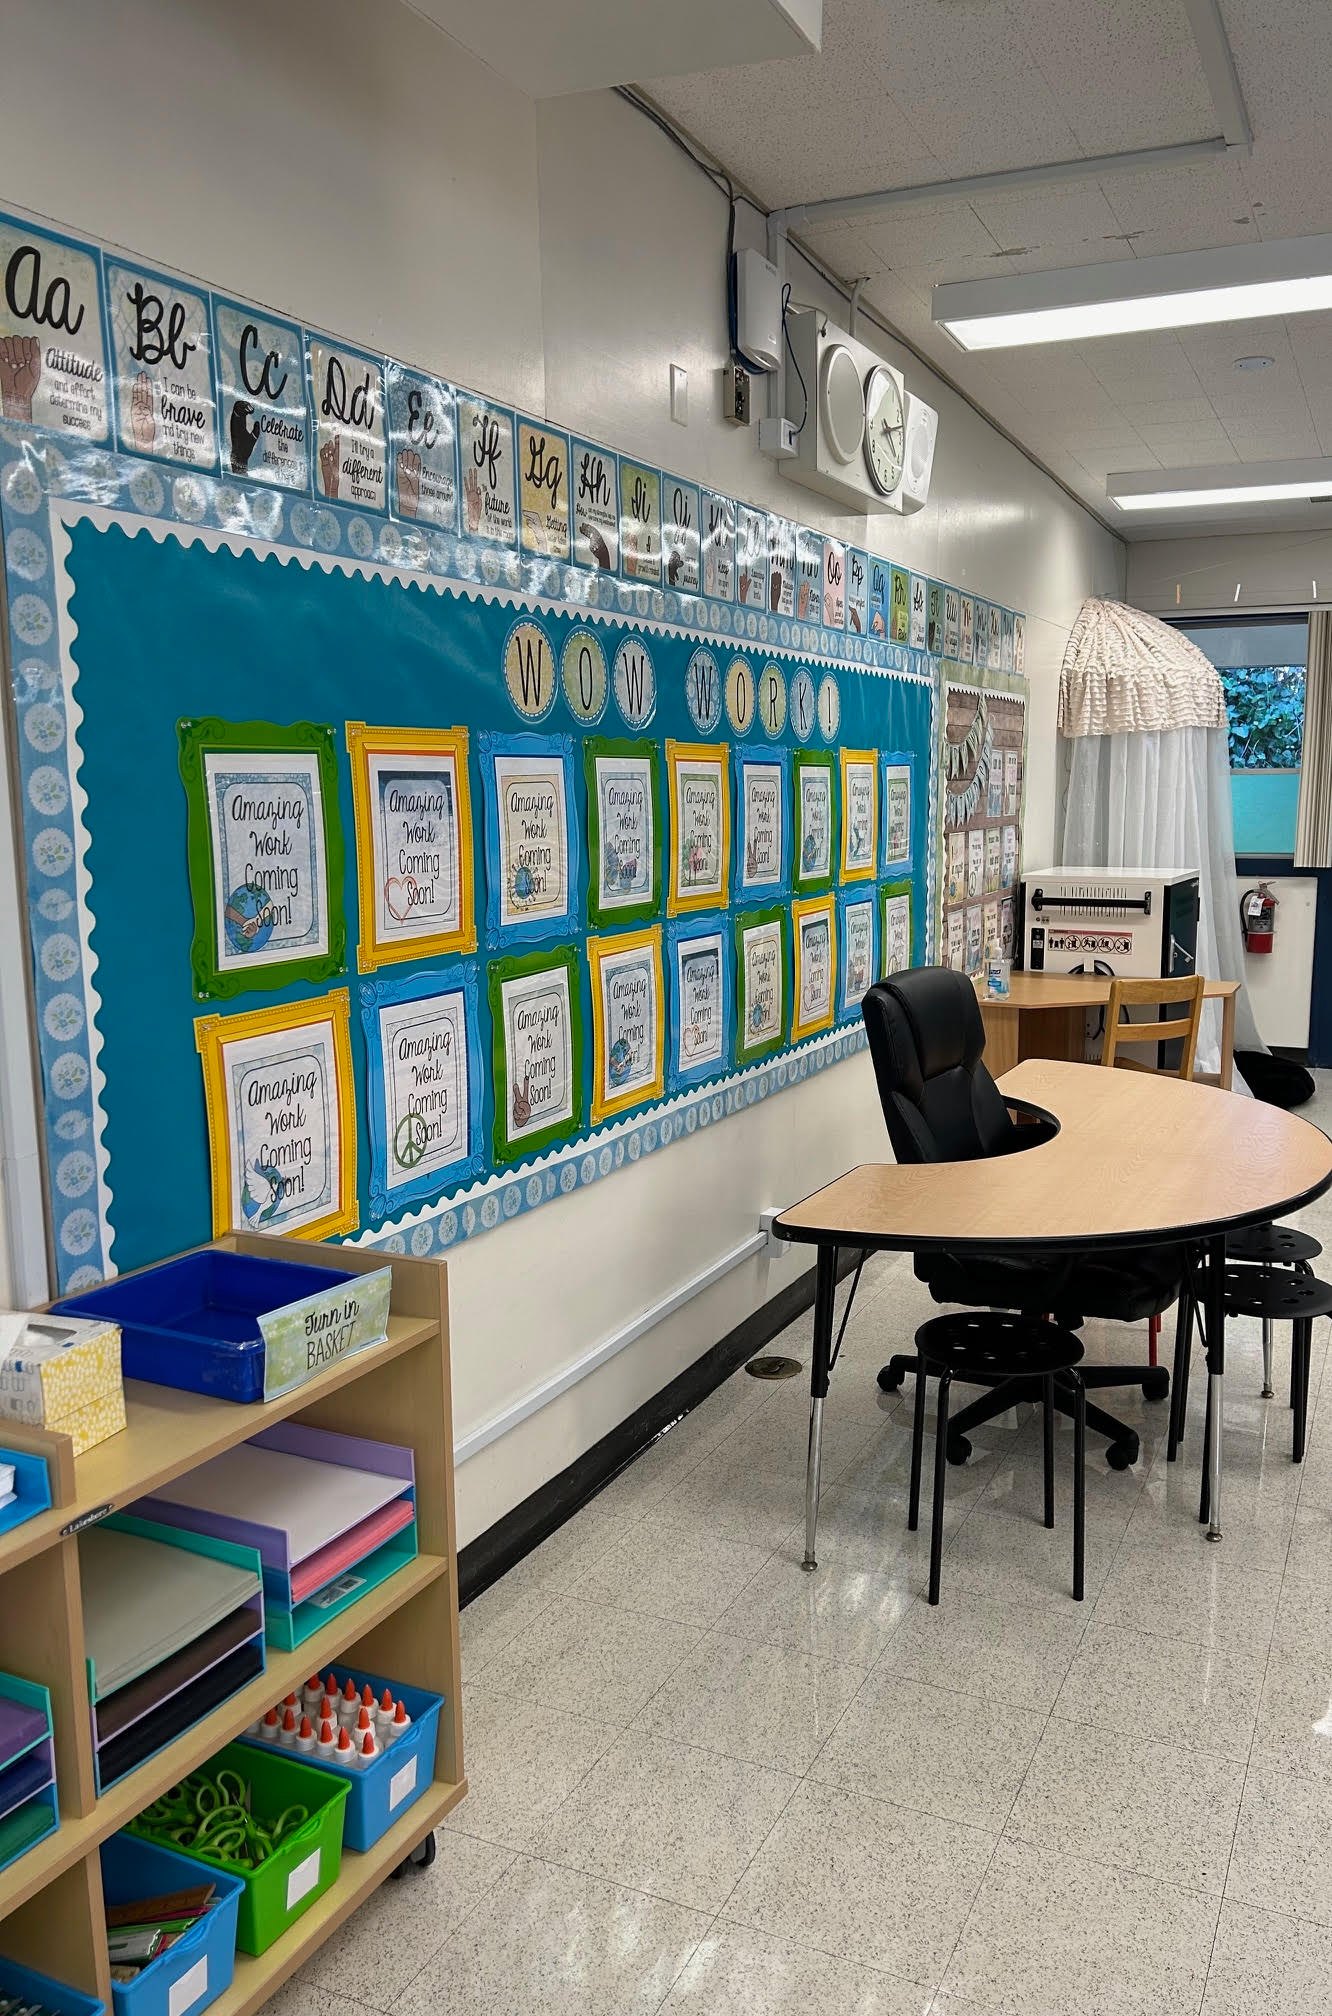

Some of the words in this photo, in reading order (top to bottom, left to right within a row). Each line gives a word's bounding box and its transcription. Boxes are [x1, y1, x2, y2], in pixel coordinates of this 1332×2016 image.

[5, 245, 85, 335] Aa
[126, 282, 196, 370] Bb
[239, 324, 288, 400] Cc
[163, 377, 168, 392] I
[171, 384, 185, 397] can
[187, 384, 196, 400] be
[322, 357, 375, 430] Dd
[161, 395, 205, 429] brave
[176, 427, 189, 445] try
[261, 415, 304, 442] Celebrate
[173, 442, 195, 462] things
[342, 457, 383, 484] different
[485, 491, 511, 515] future
[515, 636, 645, 715] WOW
[694, 662, 833, 732] WORK!
[390, 789, 444, 819] Amazing
[511, 792, 554, 818] Amazing
[609, 787, 643, 811] Amazing
[686, 787, 715, 810] Amazing
[752, 787, 775, 808] Amazing
[232, 794, 304, 830] Amazing
[617, 812, 638, 831] Work
[693, 810, 710, 827] Work
[402, 820, 436, 844] Work
[522, 818, 548, 840] Work
[690, 829, 712, 853] Coming
[753, 826, 772, 847] Coming
[250, 831, 292, 856] Work
[615, 834, 640, 859] Coming
[399, 849, 440, 880] Coming
[519, 845, 551, 871] Coming
[244, 863, 298, 897] Coming
[406, 881, 434, 906] Soon!
[256, 897, 292, 927] Soon!
[686, 961, 716, 983] Amazing
[613, 978, 647, 1001] Amazing
[517, 1004, 560, 1031] Amazing
[621, 1001, 641, 1020] Work
[690, 1006, 712, 1027] Coming
[400, 1030, 451, 1060] Amazing
[528, 1032, 552, 1054] Work
[412, 1062, 444, 1086] Work
[524, 1055, 556, 1080] Coming
[248, 1070, 318, 1107] Amazing
[529, 1079, 551, 1106] Soon!
[408, 1088, 448, 1118] Coming
[265, 1105, 306, 1136] Work
[416, 1114, 442, 1146] Soon!
[260, 1136, 312, 1170] Coming
[270, 1166, 304, 1203] Soon!
[305, 1306, 342, 1337] Turn
[344, 1299, 359, 1319] in
[307, 1321, 356, 1370] BASKET
